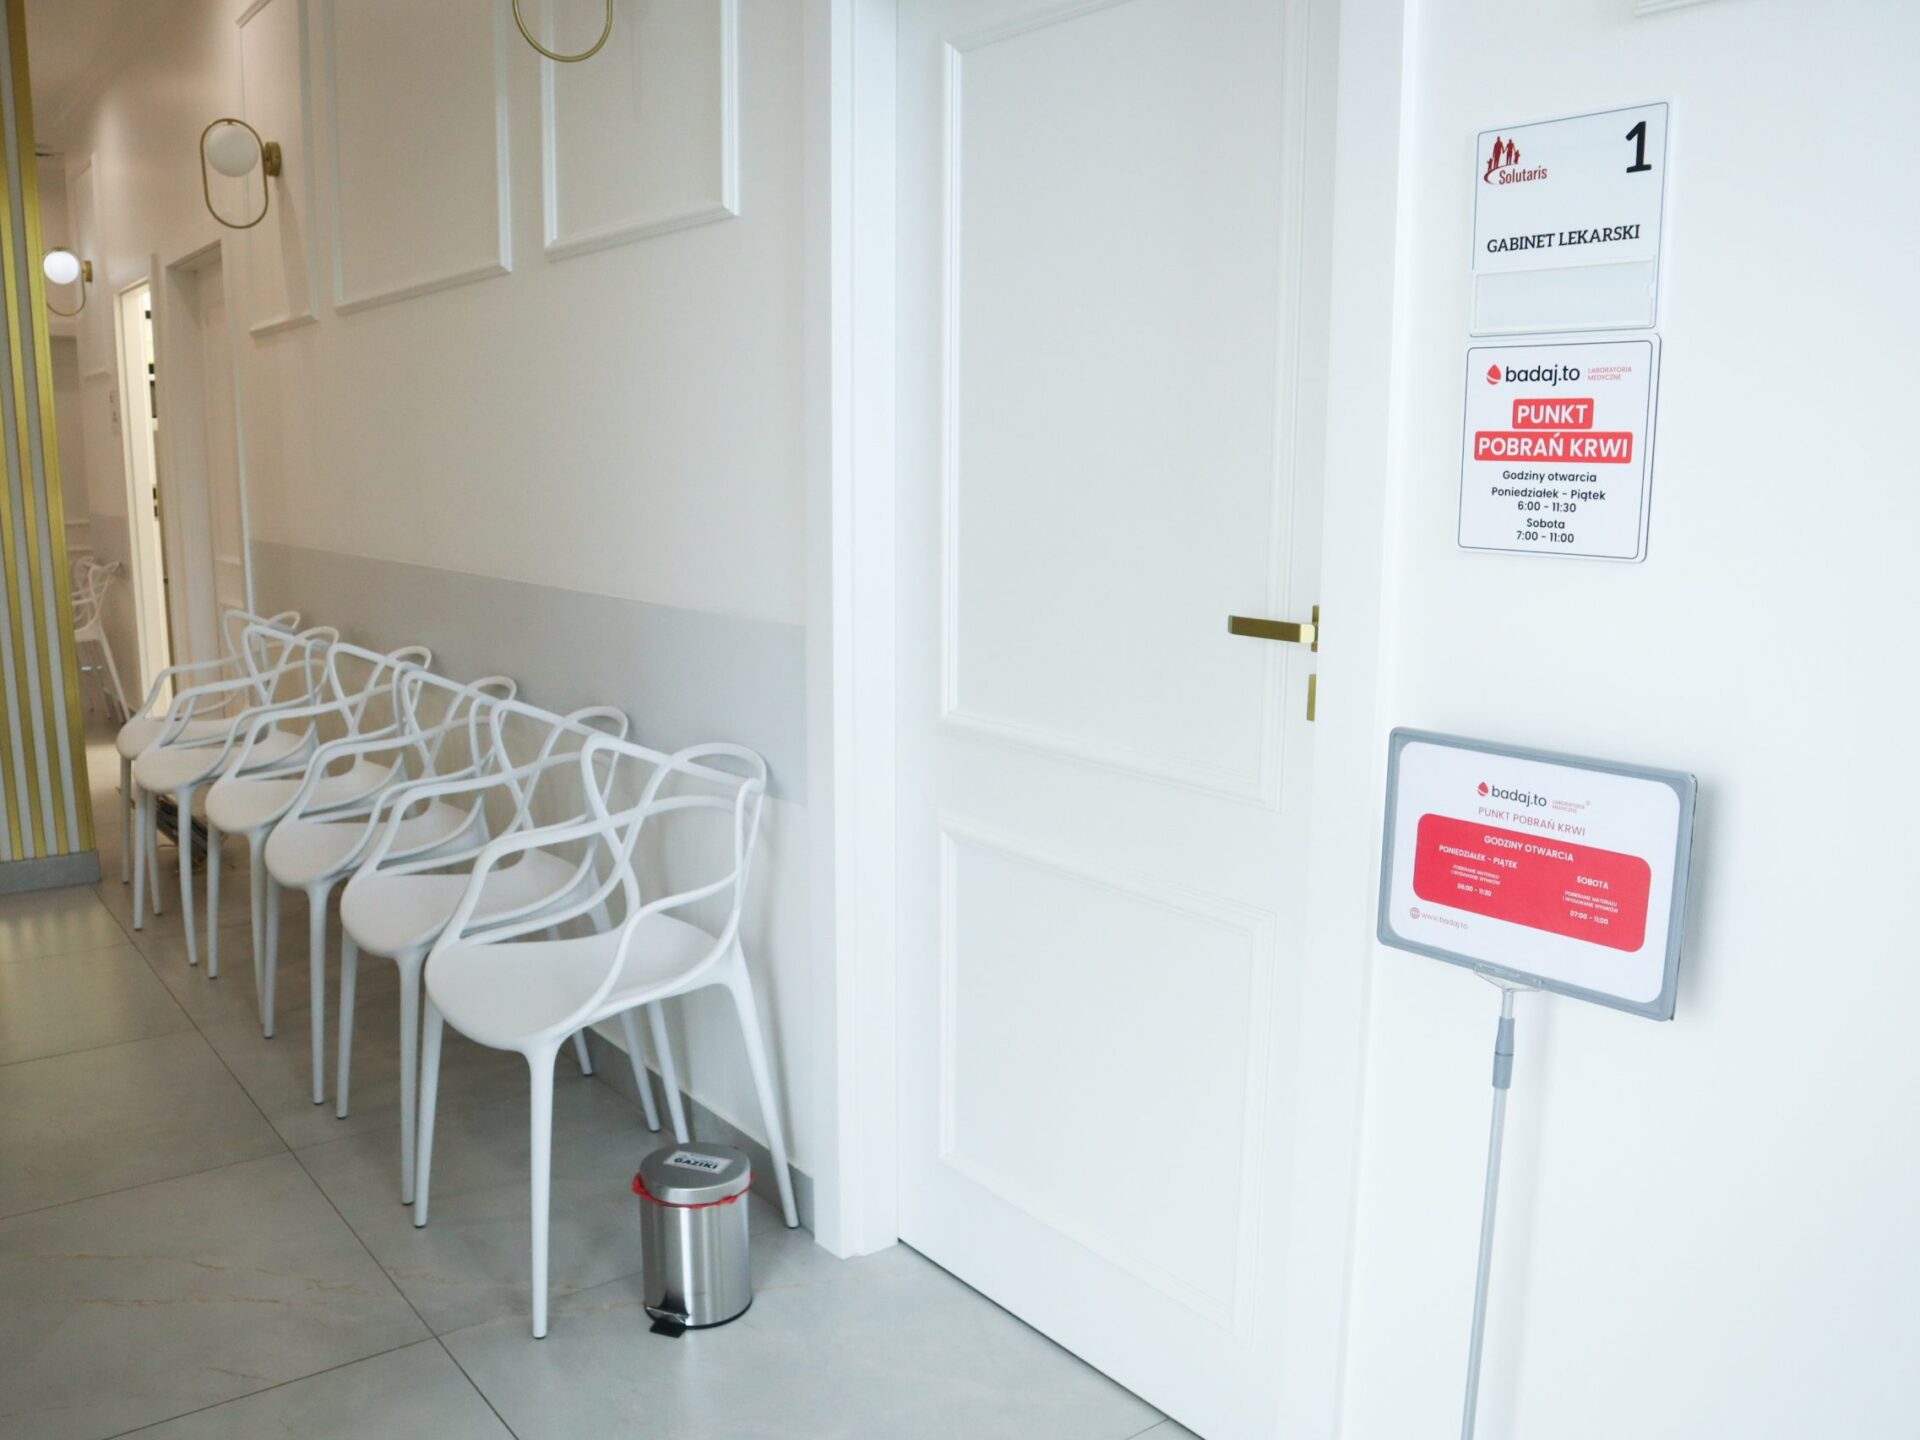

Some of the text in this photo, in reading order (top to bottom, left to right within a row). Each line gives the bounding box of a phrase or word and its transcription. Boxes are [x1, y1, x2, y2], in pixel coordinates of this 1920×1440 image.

[1625, 121, 1652, 174] 1
[1499, 165, 1547, 185] Solutaris
[1487, 224, 1641, 253] GABINET LEKARSKI
[1505, 365, 1580, 386] badaj.to
[1517, 405, 1588, 424] PUNKT
[1478, 433, 1628, 458] POBRAŃ KRWI
[1502, 470, 1597, 484] Godziny otwarcia
[1491, 487, 1559, 499] Poniedziałek
[1570, 488, 1606, 502] Piątek
[1517, 501, 1541, 511] 6:00
[1552, 502, 1576, 513] 11:30
[1526, 518, 1565, 529] Sobota
[1516, 531, 1538, 541] 7:00
[1549, 532, 1574, 543] 11:00
[1491, 785, 1547, 807] badaj.to
[1478, 807, 1586, 836] PUNKT POBRAŃ KRWI
[1484, 835, 1574, 862] GODZINY OTWARCIA
[1576, 875, 1609, 890] SOBOTA
[674, 1157, 718, 1169] GAZIKI
